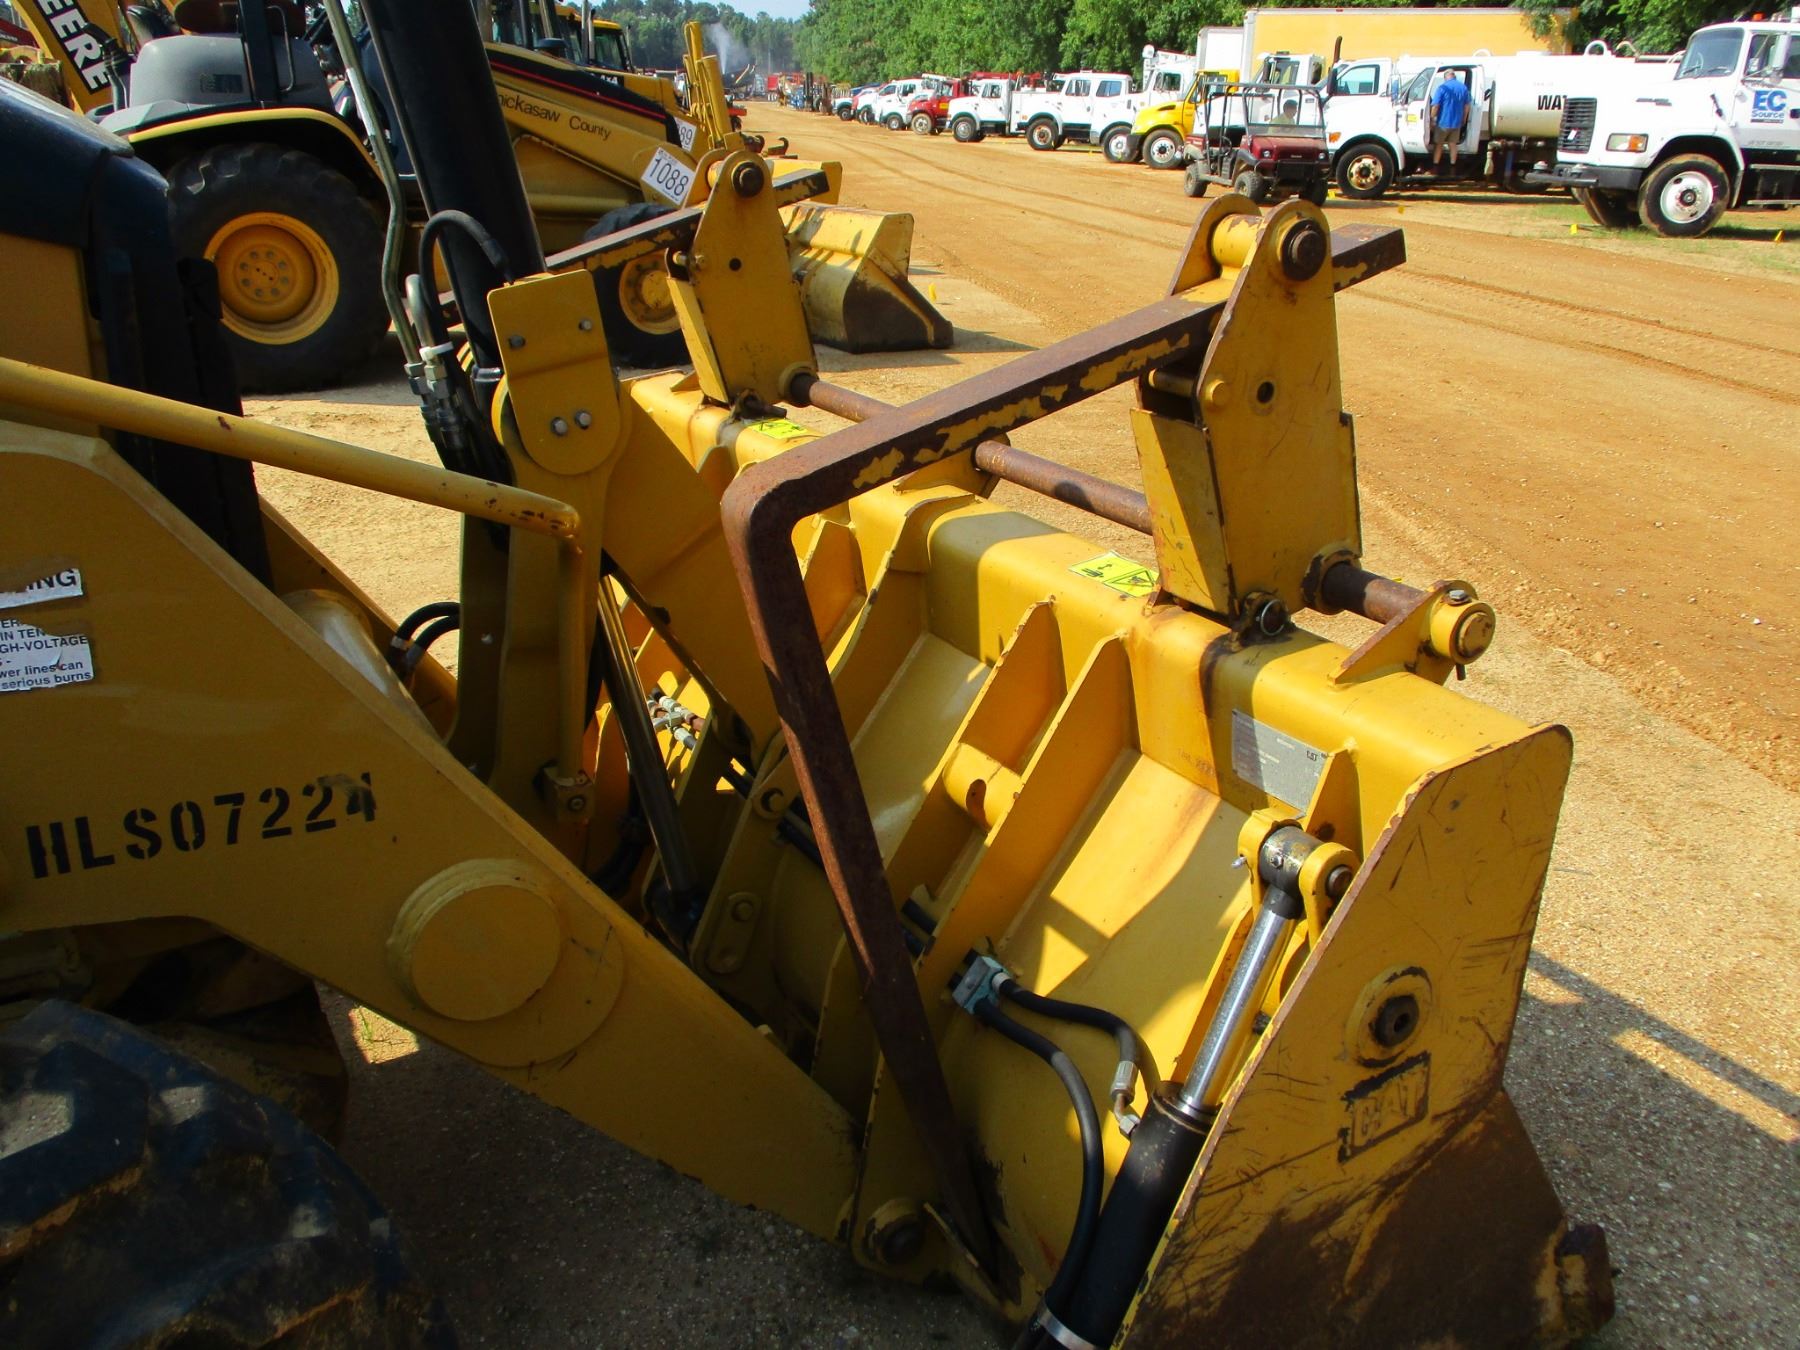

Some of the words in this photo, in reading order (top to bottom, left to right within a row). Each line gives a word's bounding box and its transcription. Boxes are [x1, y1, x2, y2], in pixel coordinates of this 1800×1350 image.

[1753, 90, 1787, 111] EC
[1751, 110, 1785, 118] Source
[569, 115, 613, 142] County
[649, 157, 690, 197] 1088
[60, 660, 84, 672] can
[1, 676, 50, 690] serious
[54, 671, 92, 684] burns
